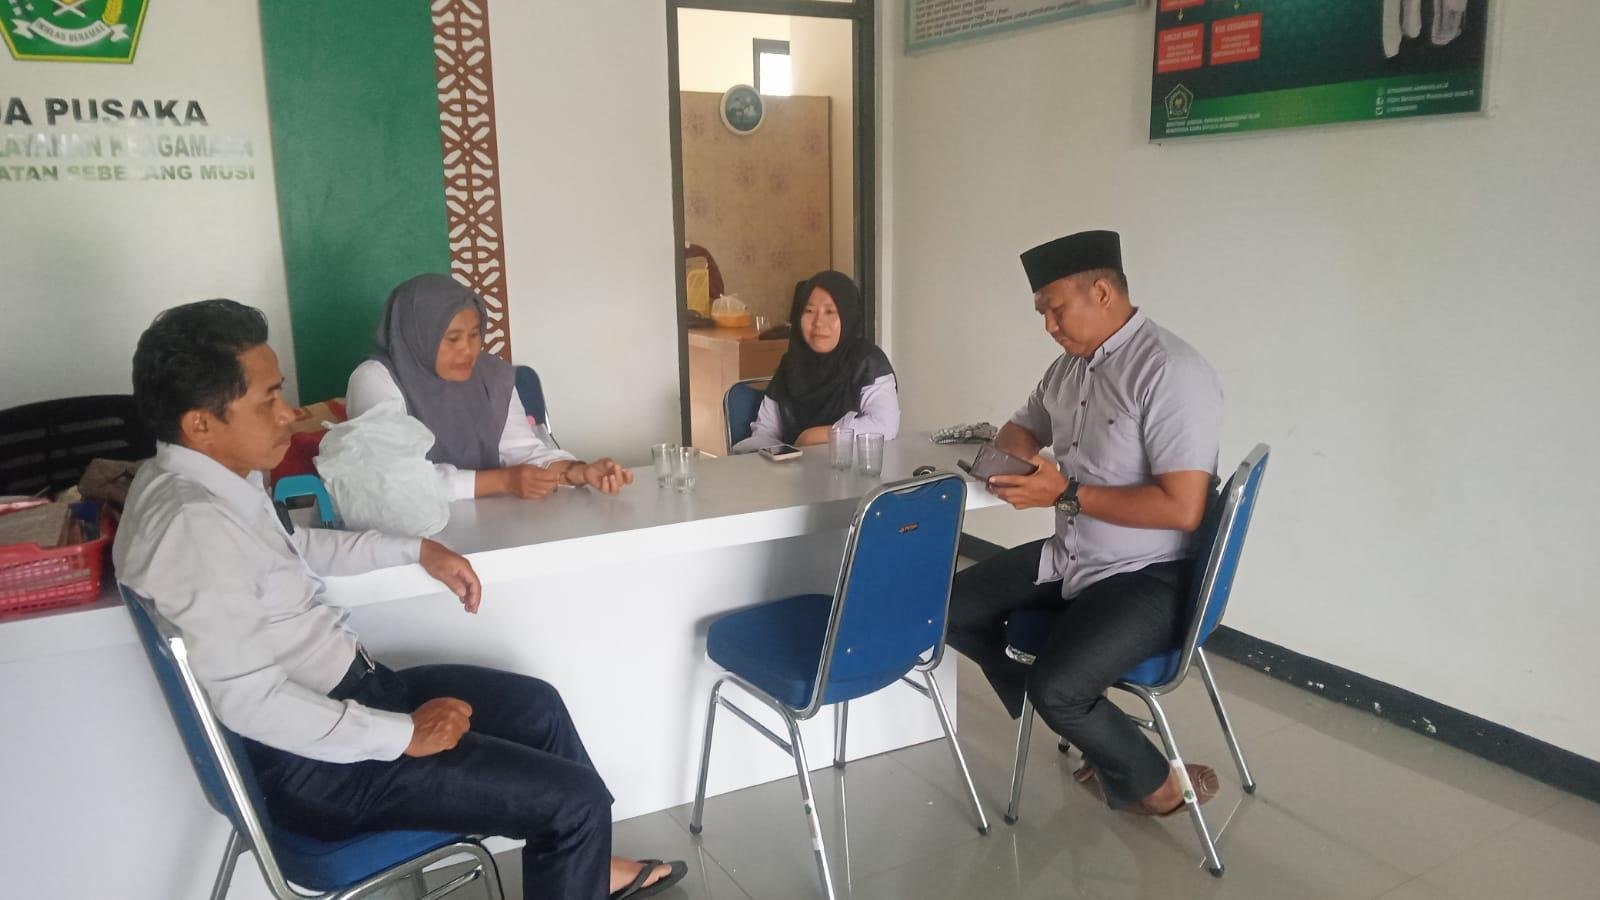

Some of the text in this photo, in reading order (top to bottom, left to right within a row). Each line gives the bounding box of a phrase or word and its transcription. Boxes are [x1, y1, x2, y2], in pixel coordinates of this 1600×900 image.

[0, 97, 208, 127] A PUSAKA
[67, 165, 192, 181] SEBEANG
[200, 165, 255, 181] MUSI
